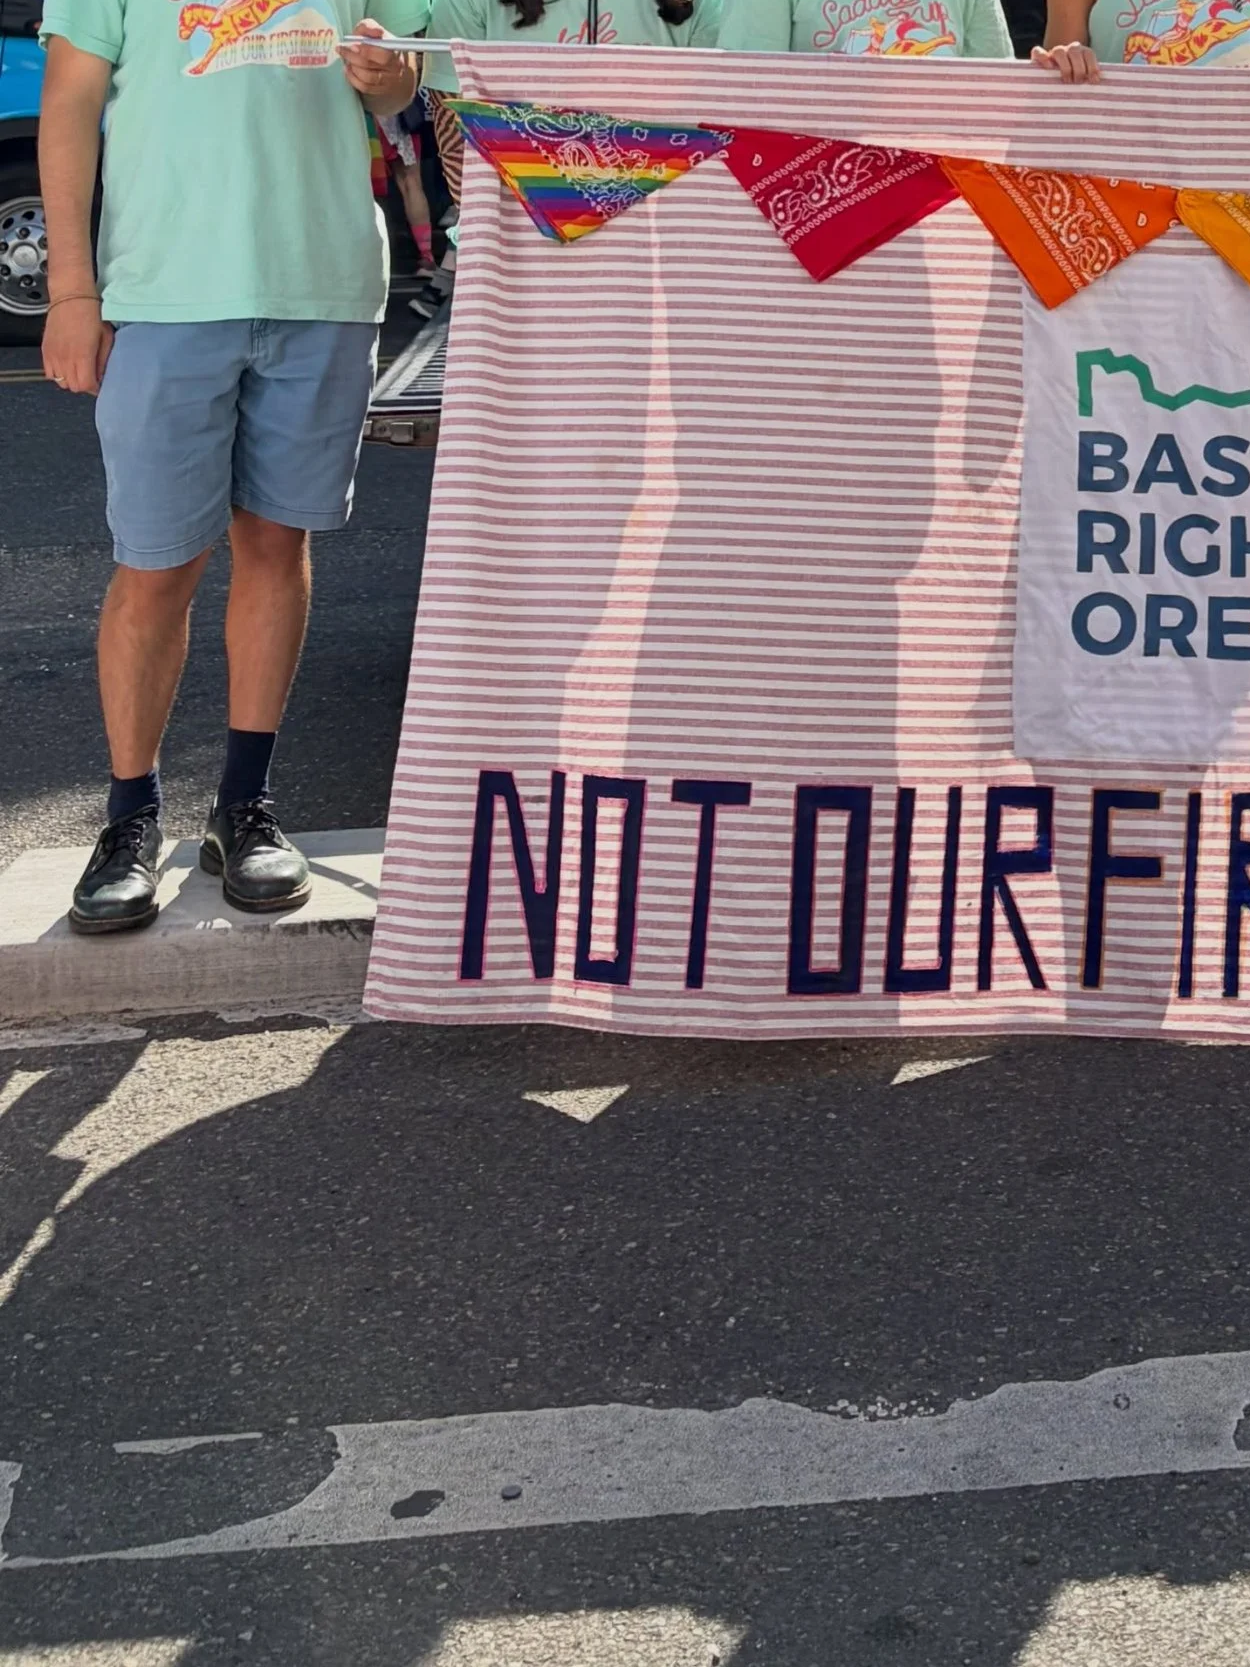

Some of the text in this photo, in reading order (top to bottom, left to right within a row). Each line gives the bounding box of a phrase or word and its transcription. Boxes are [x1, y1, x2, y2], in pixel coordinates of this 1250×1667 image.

[913, 0, 955, 36] up
[459, 770, 753, 990] NOT
[786, 784, 1054, 996] OUR
